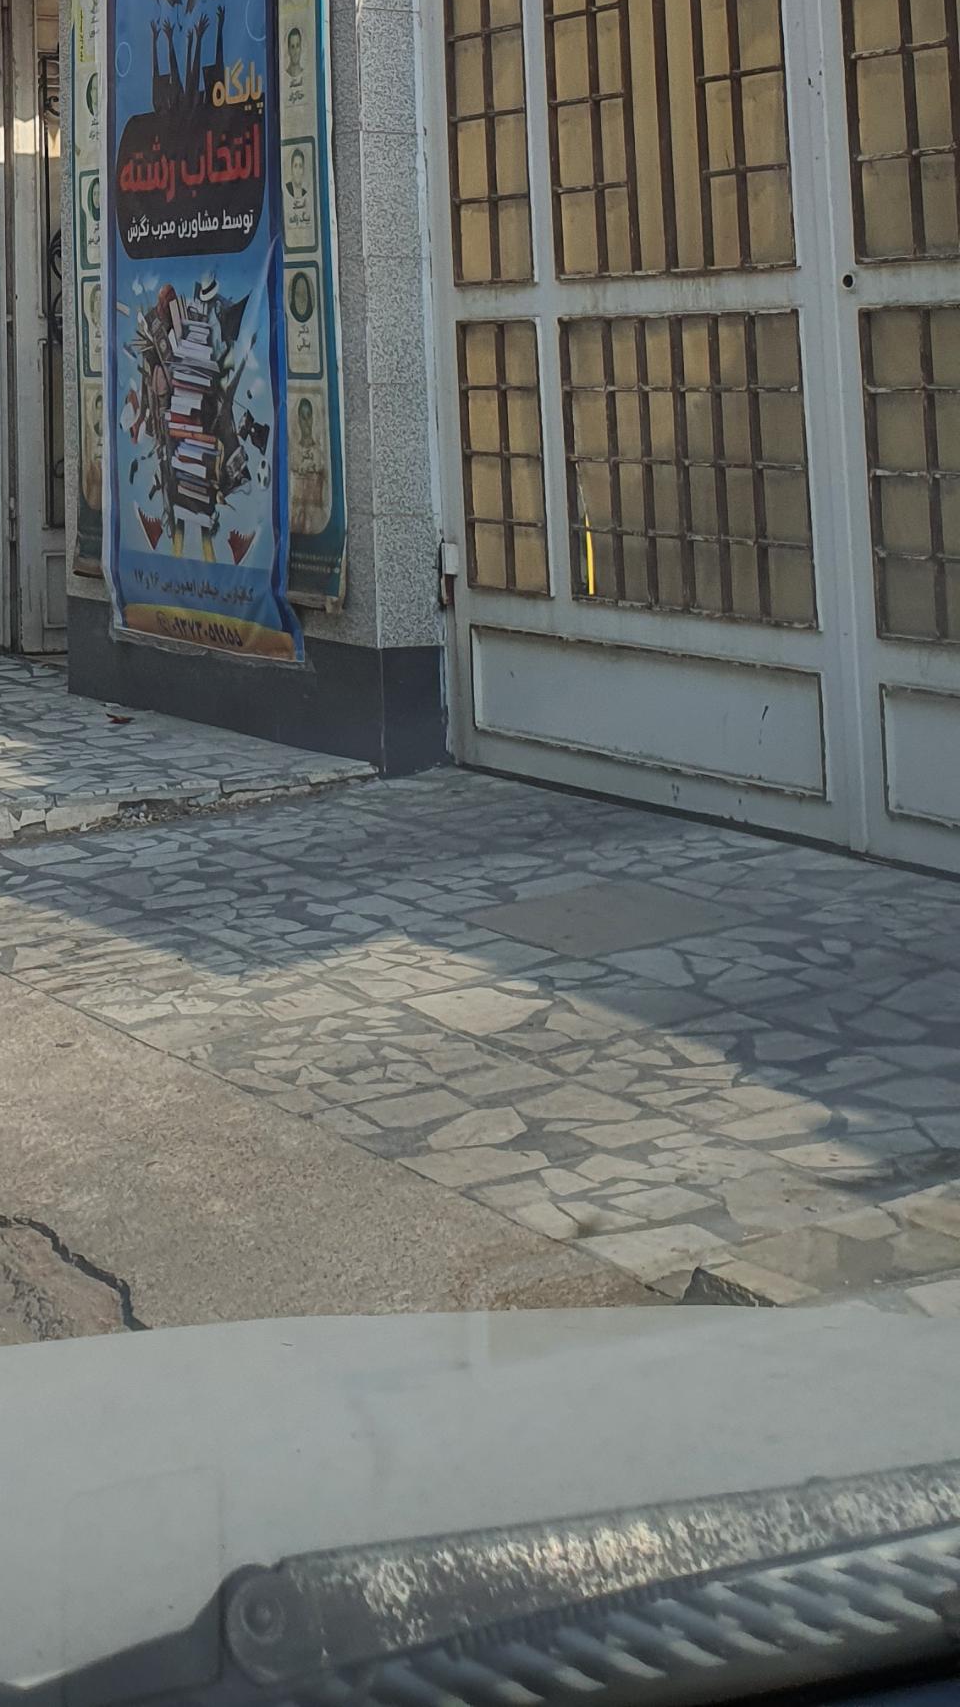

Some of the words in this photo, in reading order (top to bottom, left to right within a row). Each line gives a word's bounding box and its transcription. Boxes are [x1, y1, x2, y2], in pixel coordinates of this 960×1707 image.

[212, 59, 264, 114] پایگاه
[120, 135, 176, 203] رشته
[182, 123, 260, 198] انتخاب
[127, 213, 150, 243] نگرش
[151, 219, 176, 240] مجرب
[177, 210, 219, 239] مشاورین
[221, 208, 254, 234] توسط
